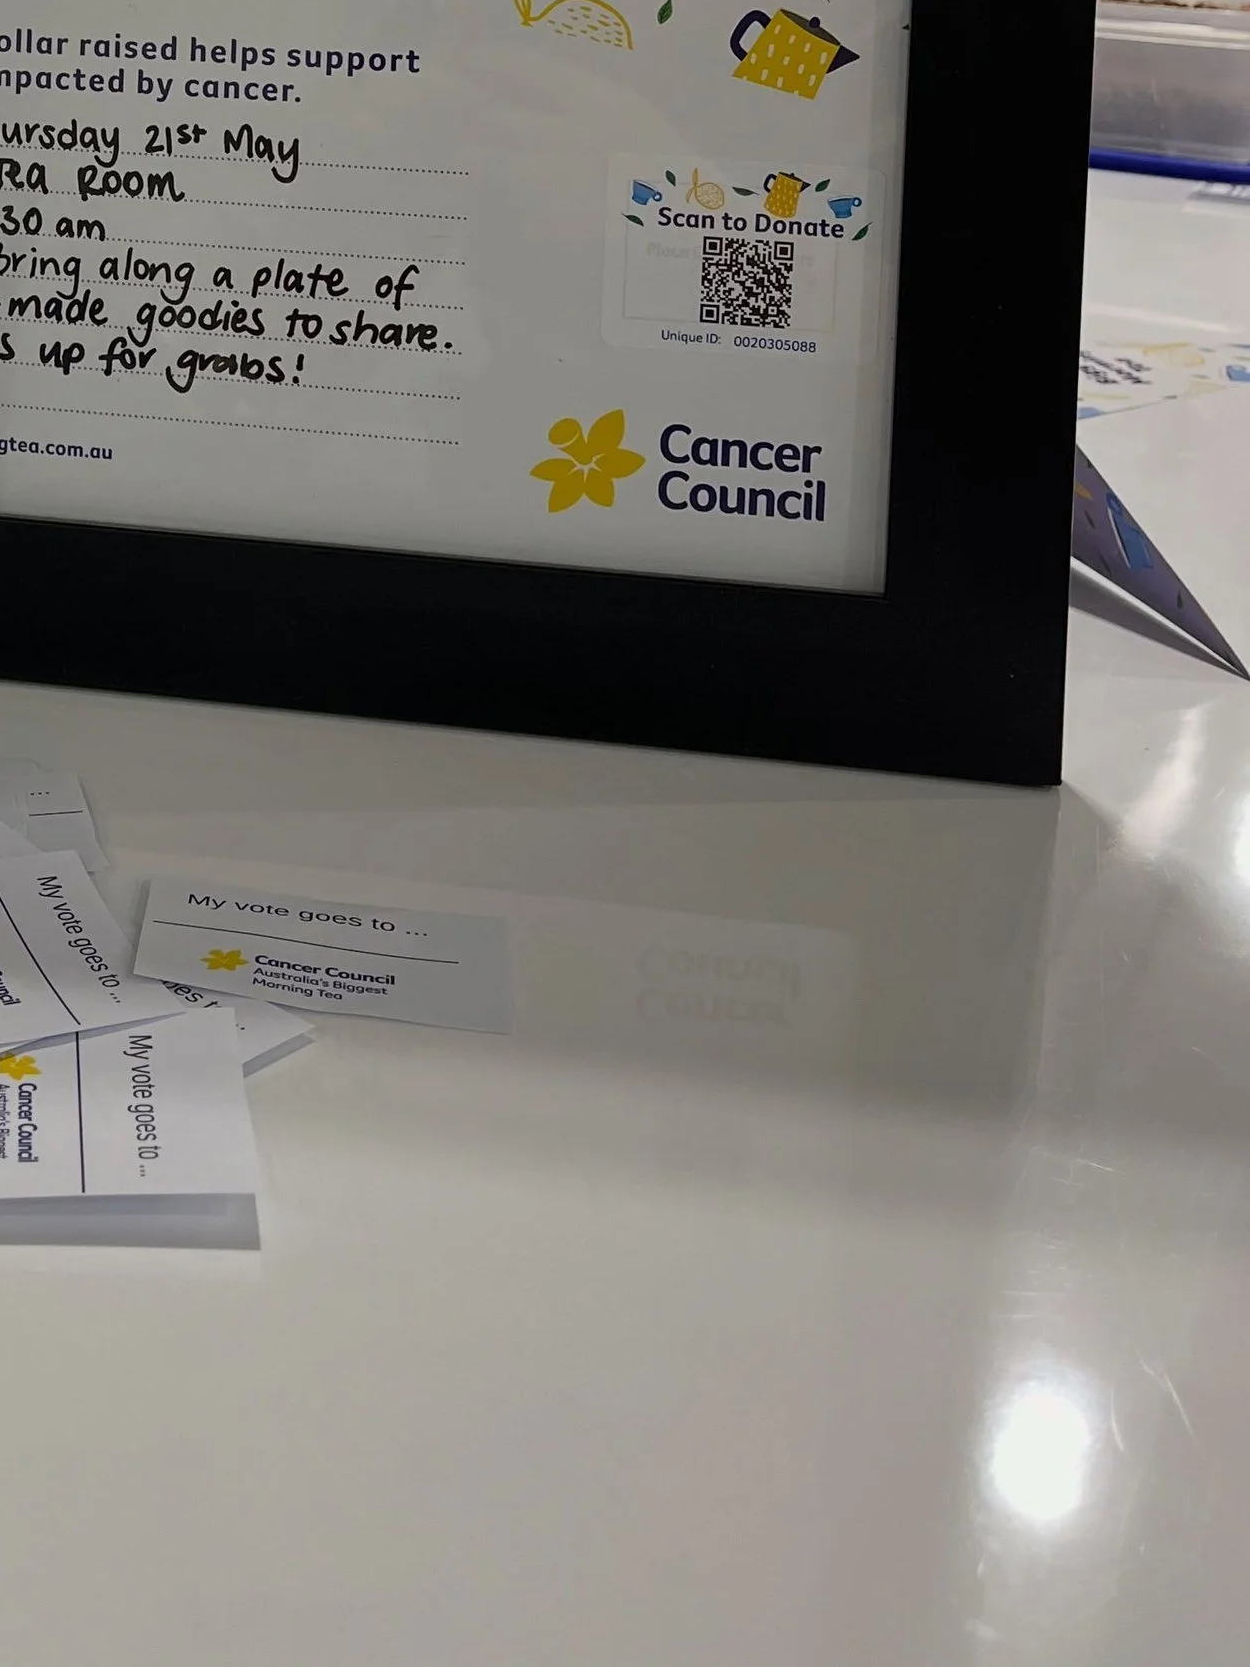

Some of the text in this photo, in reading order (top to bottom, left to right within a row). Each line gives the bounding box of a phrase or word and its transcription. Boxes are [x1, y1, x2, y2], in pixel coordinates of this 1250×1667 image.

[79, 34, 177, 61] raised
[190, 37, 276, 71] helps
[287, 49, 420, 77] support
[138, 69, 173, 102] by
[184, 77, 301, 103] cancer.
[145, 123, 207, 157] 21st
[224, 123, 299, 183] May
[77, 165, 185, 202] Room
[55, 216, 106, 241] am
[657, 206, 845, 239] Scan to Donate
[99, 247, 195, 305] along
[213, 266, 234, 289] a
[251, 258, 349, 298] plate
[375, 264, 420, 311] of
[127, 299, 265, 347] goodies
[285, 308, 323, 339] to
[329, 309, 453, 350] share.
[661, 330, 817, 353] Unique ID: 0020305088
[39, 340, 85, 375] up
[98, 336, 157, 376] for
[166, 349, 305, 393] grabs!
[659, 423, 822, 473] Cancer
[657, 470, 826, 521] Council
[188, 893, 227, 910] My
[234, 901, 290, 917] vote
[298, 910, 363, 927] goes
[370, 918, 396, 932] to
[36, 875, 63, 899] My
[52, 902, 83, 934] vote
[68, 937, 110, 972] goes
[100, 973, 120, 988] to
[252, 967, 388, 996] Australia's Biggest
[252, 977, 343, 1000] Morning Tea
[254, 954, 396, 986] Cancer Council
[161, 980, 204, 1003] oes
[123, 1034, 153, 1061] My
[131, 1064, 153, 1099] vote
[17, 1082, 39, 1163] Cancer Council
[127, 1102, 157, 1142] goes
[138, 1144, 160, 1160] to
